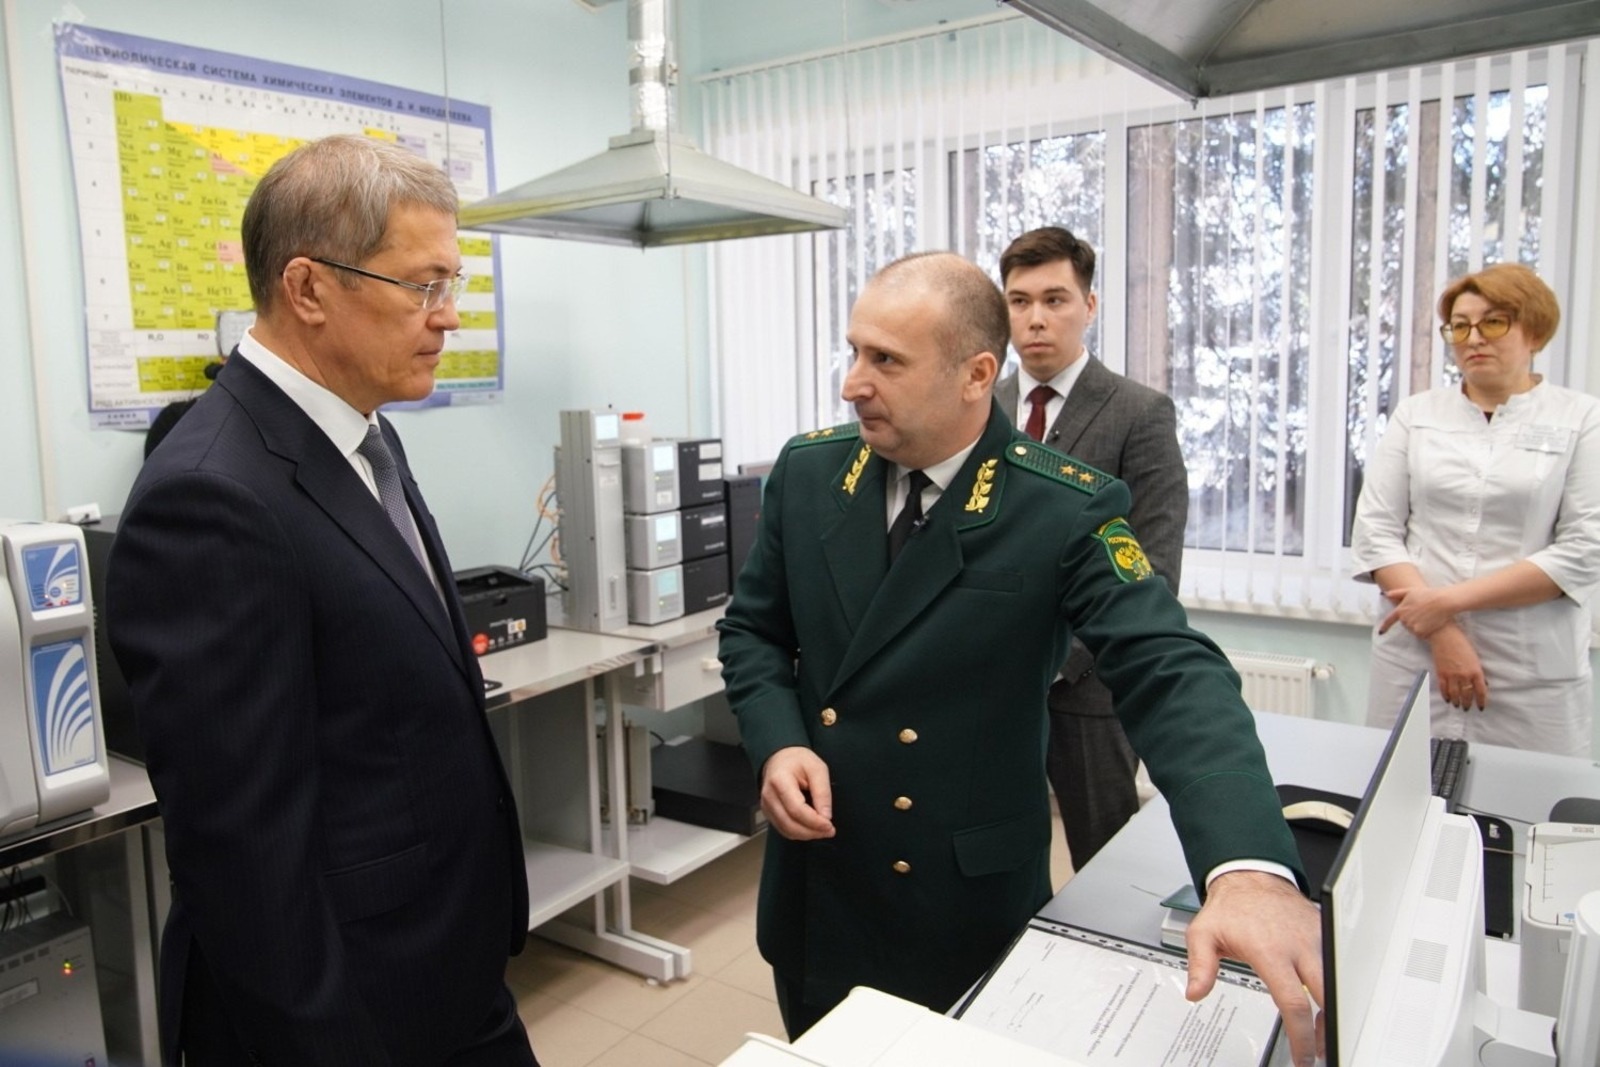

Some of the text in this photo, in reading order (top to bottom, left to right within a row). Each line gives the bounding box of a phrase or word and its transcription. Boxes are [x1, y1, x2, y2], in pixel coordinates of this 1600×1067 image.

[84, 44, 196, 72] ПЕРИОДИЧЕСКАЯ
[202, 64, 257, 83] СИСТЕМА
[262, 75, 334, 96] ХИМИЧЕСКИХ
[340, 88, 393, 108] ЭЛЕМЕНТОВ
